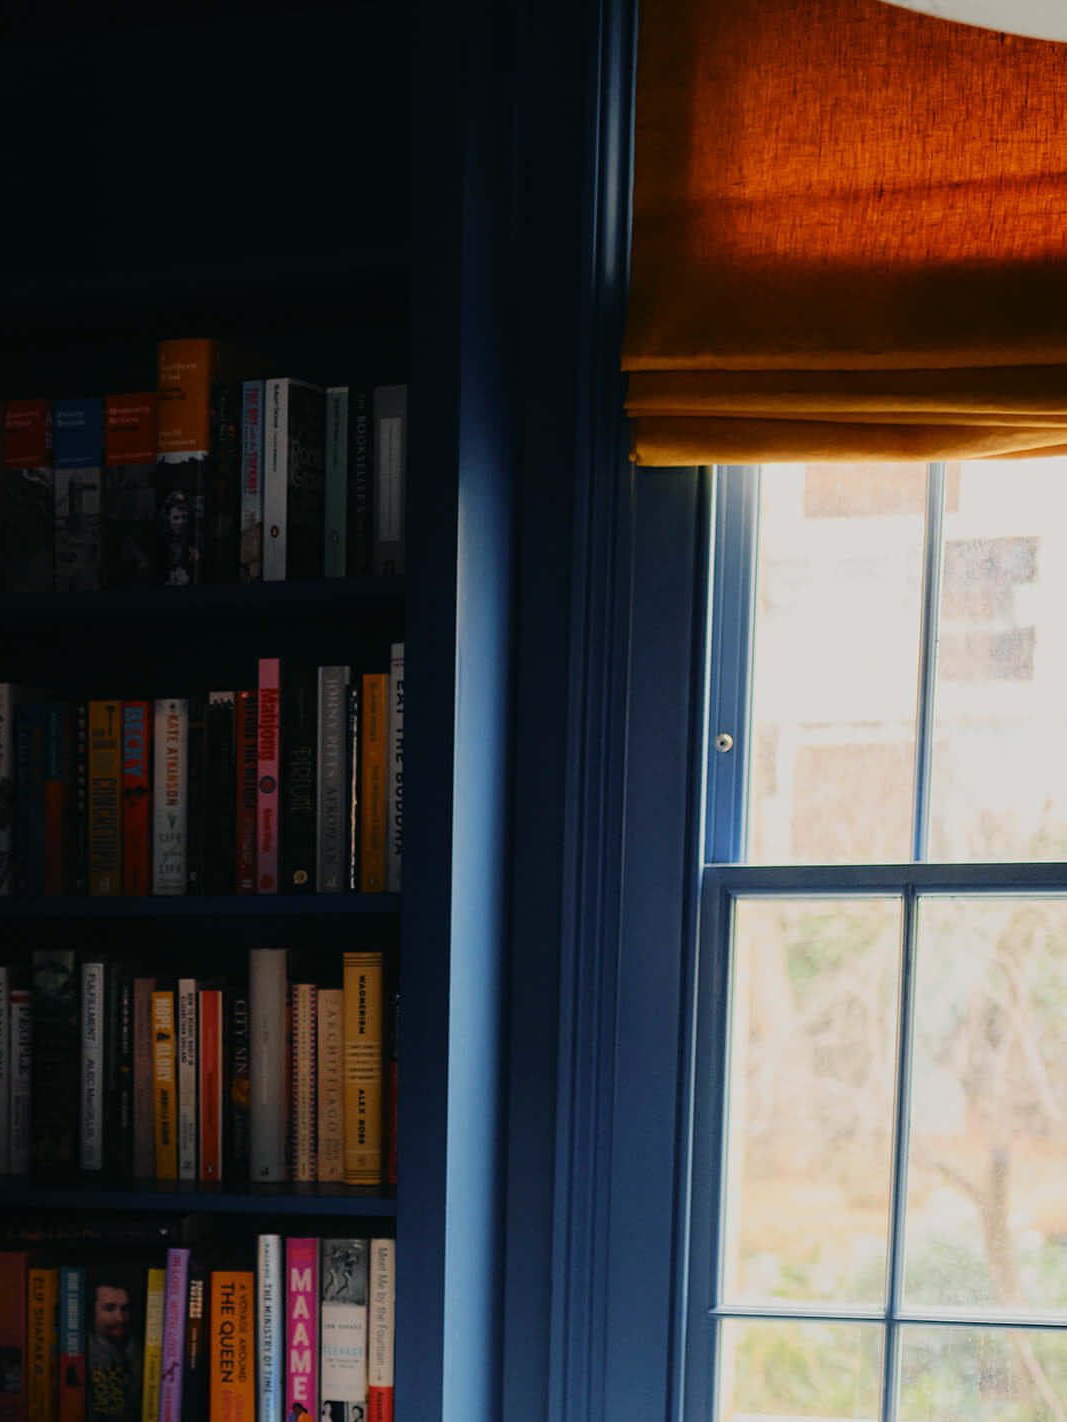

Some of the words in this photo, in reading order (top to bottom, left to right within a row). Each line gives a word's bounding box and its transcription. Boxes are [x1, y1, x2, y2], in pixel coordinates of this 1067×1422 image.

[324, 679, 341, 728] JOHNY
[123, 706, 145, 777] BECKY
[166, 715, 179, 743] KATE
[258, 688, 279, 761] Mahjong
[324, 735, 341, 777] PITTS
[395, 728, 405, 765] THE
[165, 748, 179, 807] ATKINSON
[323, 786, 341, 866] AFROPEAN
[85, 971, 98, 1043] FULFILLMENT
[155, 997, 173, 1031] HOPE
[234, 999, 250, 1035] CITY
[358, 975, 368, 1035] WAGNERISM
[155, 1032, 171, 1042] &
[85, 1058, 97, 1084] ALEC
[155, 1043, 173, 1083] GLORY
[235, 1046, 249, 1074] SIN
[358, 1088, 368, 1114] ALEX
[358, 1119, 368, 1145] ROSS
[376, 1247, 389, 1272] Meet
[220, 1281, 236, 1315] THE
[263, 1283, 274, 1302] THE
[374, 1292, 389, 1305] by
[376, 1274, 389, 1291] Me
[237, 1294, 248, 1333] VOYAGE
[263, 1305, 274, 1352] MINISTRY
[376, 1306, 389, 1322] the
[218, 1320, 236, 1384] QUEEN
[290, 1267, 313, 1401] MAAME
[375, 1324, 388, 1367] Fountain
[237, 1338, 248, 1383] AROUND
[263, 1355, 274, 1368] OF
[263, 1370, 274, 1394] TIME
